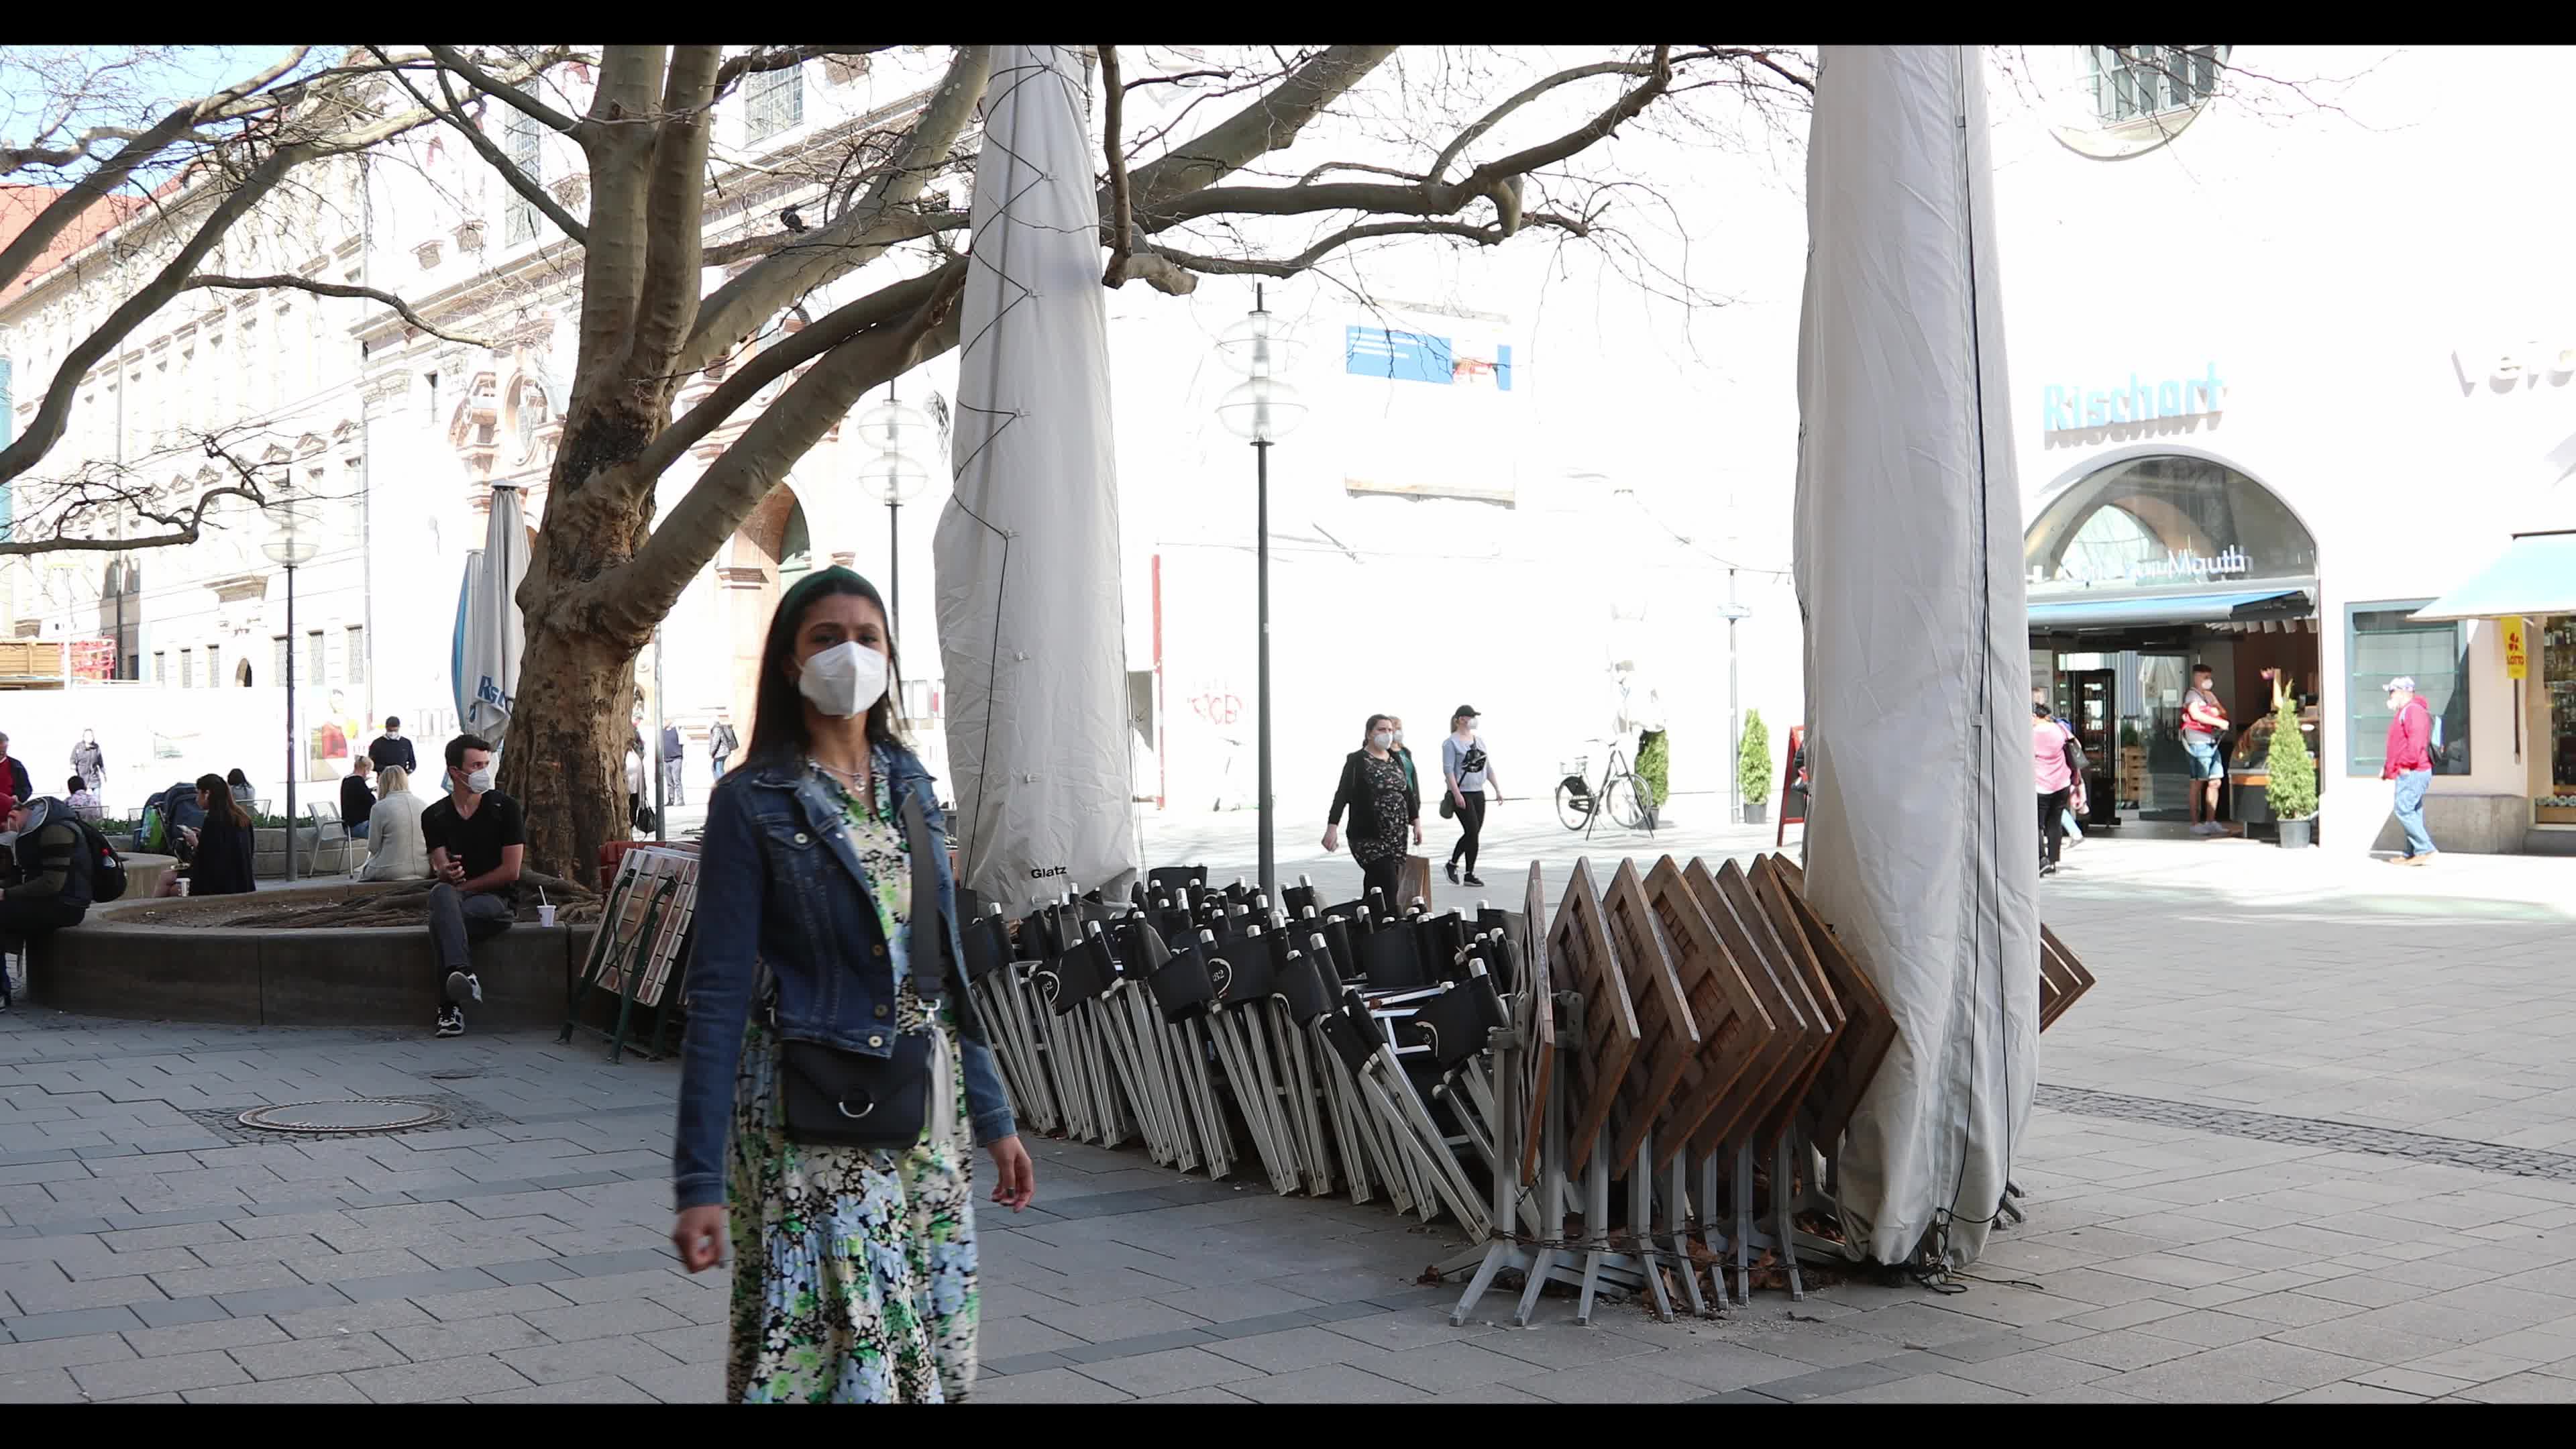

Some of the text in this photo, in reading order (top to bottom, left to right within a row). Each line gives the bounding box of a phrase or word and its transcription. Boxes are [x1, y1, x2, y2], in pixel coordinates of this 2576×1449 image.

[2043, 361, 2223, 431] Rischart
[2167, 544, 2245, 579] Mauth
[1030, 866, 1067, 879] Glatz
